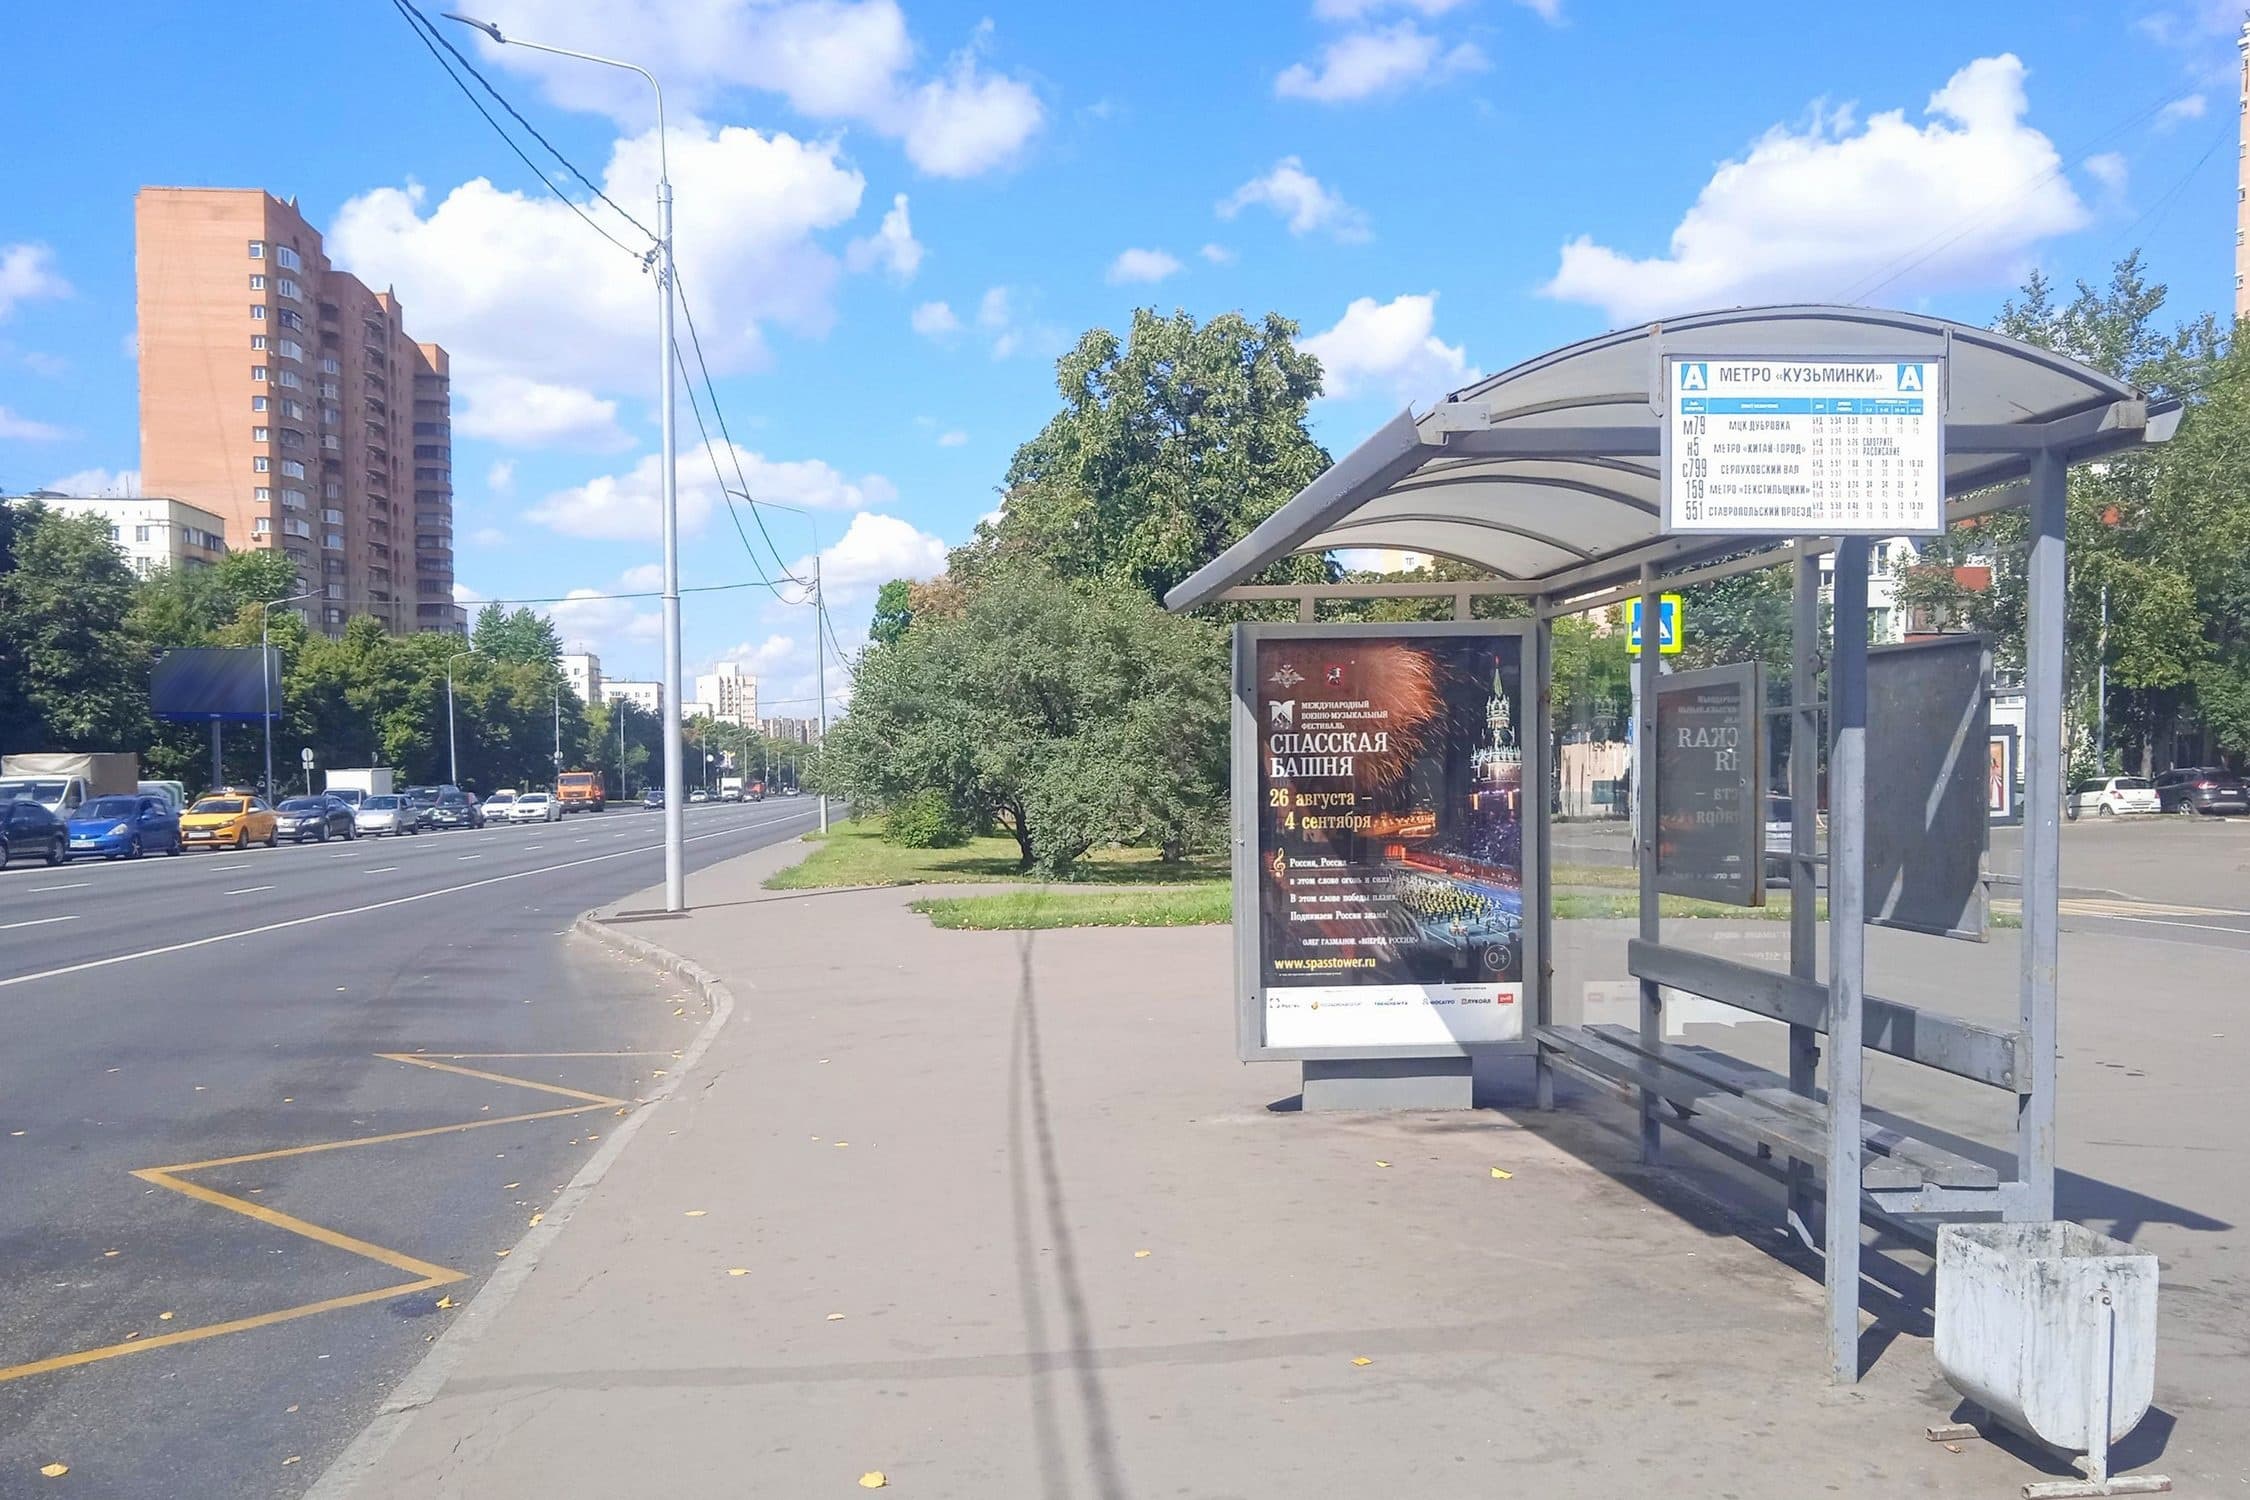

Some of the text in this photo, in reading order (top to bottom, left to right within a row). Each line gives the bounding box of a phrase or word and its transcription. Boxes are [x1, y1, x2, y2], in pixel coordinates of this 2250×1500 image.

[1720, 367, 1883, 383] МЕТРО «КУЗЬМИНКИ»
[1729, 420, 1791, 431] МЦК ДУБРОВКА
[1714, 443, 1741, 453] МЕТРО
[1720, 464, 1799, 474] СЕРПУХОВСКИЙ ВАЛ
[1686, 479, 1704, 499] 159
[1709, 485, 1737, 495] МЕТРО
[1739, 484, 1810, 496] «ТЕКСТИЛЬЩИКИ»
[1685, 500, 1703, 520] 551
[1708, 506, 1780, 517] СТАВРОПОЛЬСКИЙ
[1781, 506, 1812, 518] ПРОЕЗД
[1301, 700, 1370, 710] МЕЖДУНАРОДНЫЙ
[1301, 711, 1389, 720] ВОЕННО-МУЗЫКАЛЬНЫЙ
[1301, 722, 1345, 730] ФЕСТИВАЛЬ
[1270, 732, 1389, 754] СПАССКАЯ
[1270, 756, 1354, 778] БАШНЯ
[1269, 788, 1289, 807] 26
[1295, 792, 1355, 810] августа
[1284, 811, 1371, 832] 4 сентября
[1290, 893, 1297, 903] В
[1290, 911, 1333, 922] Поднимаем
[1274, 957, 1376, 971] www.spasstower.ru
